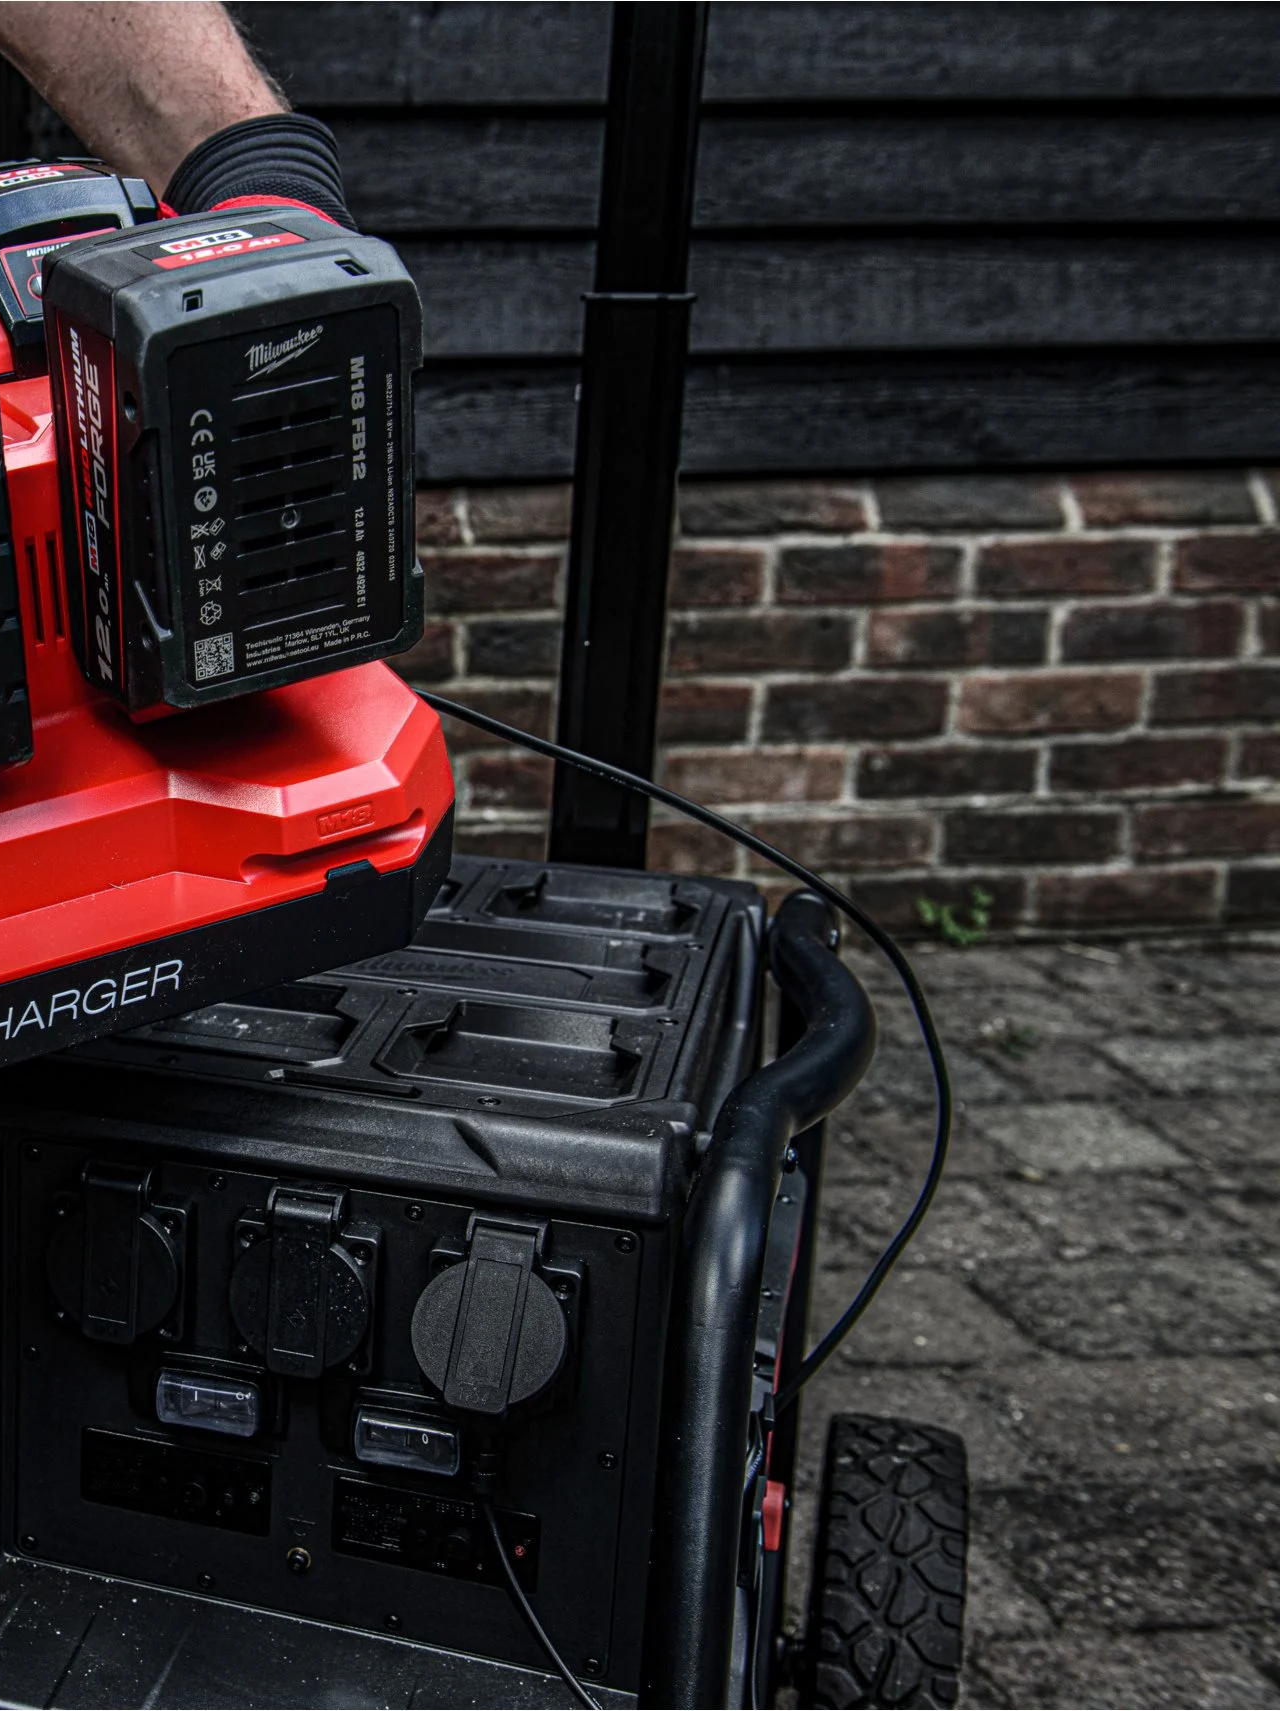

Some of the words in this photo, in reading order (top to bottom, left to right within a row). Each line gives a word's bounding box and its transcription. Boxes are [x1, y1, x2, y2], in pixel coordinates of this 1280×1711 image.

[168, 231, 244, 251] M18
[179, 241, 244, 261] 12.0
[248, 237, 282, 249] Ah
[349, 356, 365, 411] M18
[69, 327, 94, 508] REDLITHIUM
[83, 353, 110, 529] FORGE
[351, 417, 366, 480] FB12
[354, 506, 364, 528] 12.0
[85, 515, 98, 568] M18
[354, 528, 364, 541] Ah
[355, 549, 365, 573] 4932
[355, 572, 366, 596] 4926
[356, 595, 366, 609] 51
[91, 588, 115, 680] 12.0
[284, 630, 303, 641] 71364
[342, 613, 370, 628] Germany
[323, 637, 342, 648] Made
[349, 629, 370, 641] P.R.C.
[339, 625, 349, 634] UK
